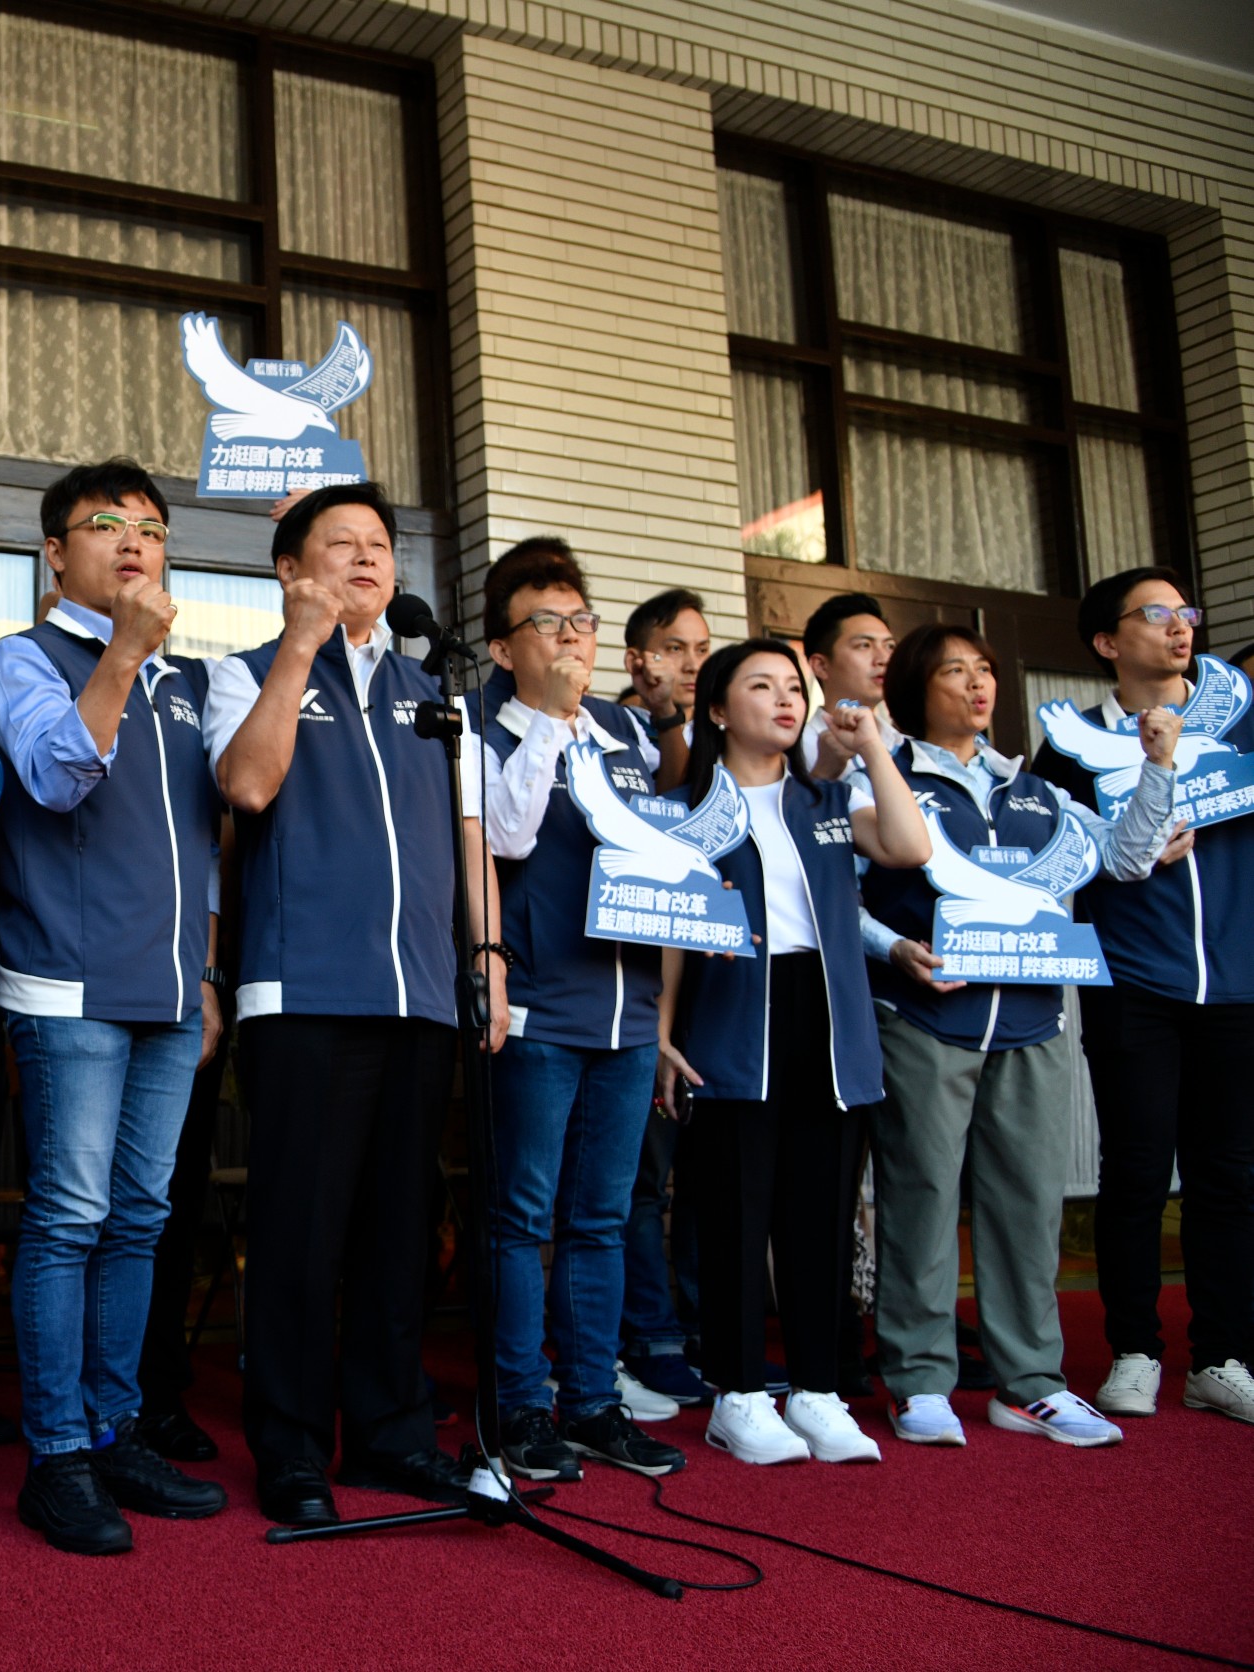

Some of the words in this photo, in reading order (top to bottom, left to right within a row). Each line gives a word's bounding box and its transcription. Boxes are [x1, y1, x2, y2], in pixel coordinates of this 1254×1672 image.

[254, 362, 303, 378] 藍鷹行動
[210, 444, 324, 468] 力挺國會改革
[206, 469, 285, 492] 藍鷹翱翔
[638, 798, 685, 819] 藍鷹行動
[978, 850, 1028, 864] 藍鷹行動
[599, 881, 708, 917] 力挺國會改革
[596, 906, 671, 938] 藍鷹翱翔
[672, 916, 744, 947] 弊案現形
[942, 929, 1058, 954] 力挺國會改革
[941, 954, 1019, 977] 藍鷹翱翔
[1021, 956, 1098, 979] 弊案現形
